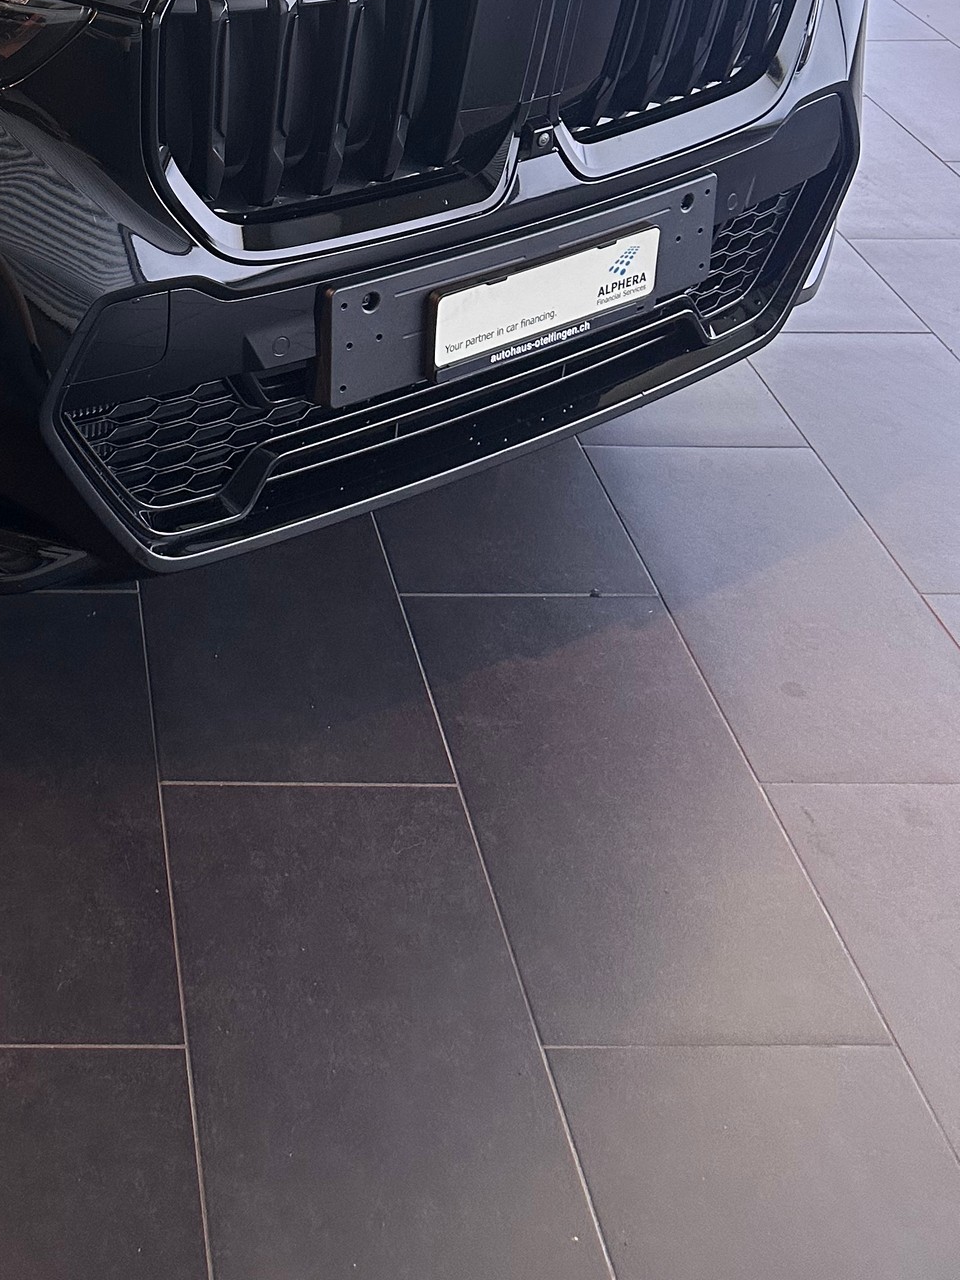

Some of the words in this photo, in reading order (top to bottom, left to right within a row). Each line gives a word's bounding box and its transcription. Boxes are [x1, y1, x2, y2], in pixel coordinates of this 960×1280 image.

[596, 292, 622, 306] Financial
[622, 284, 647, 297] Services
[597, 272, 647, 298] ALPHERA
[444, 342, 463, 354] Your
[465, 331, 495, 349] partner
[496, 327, 504, 337] in
[505, 323, 519, 334] car
[520, 310, 558, 329] financing.
